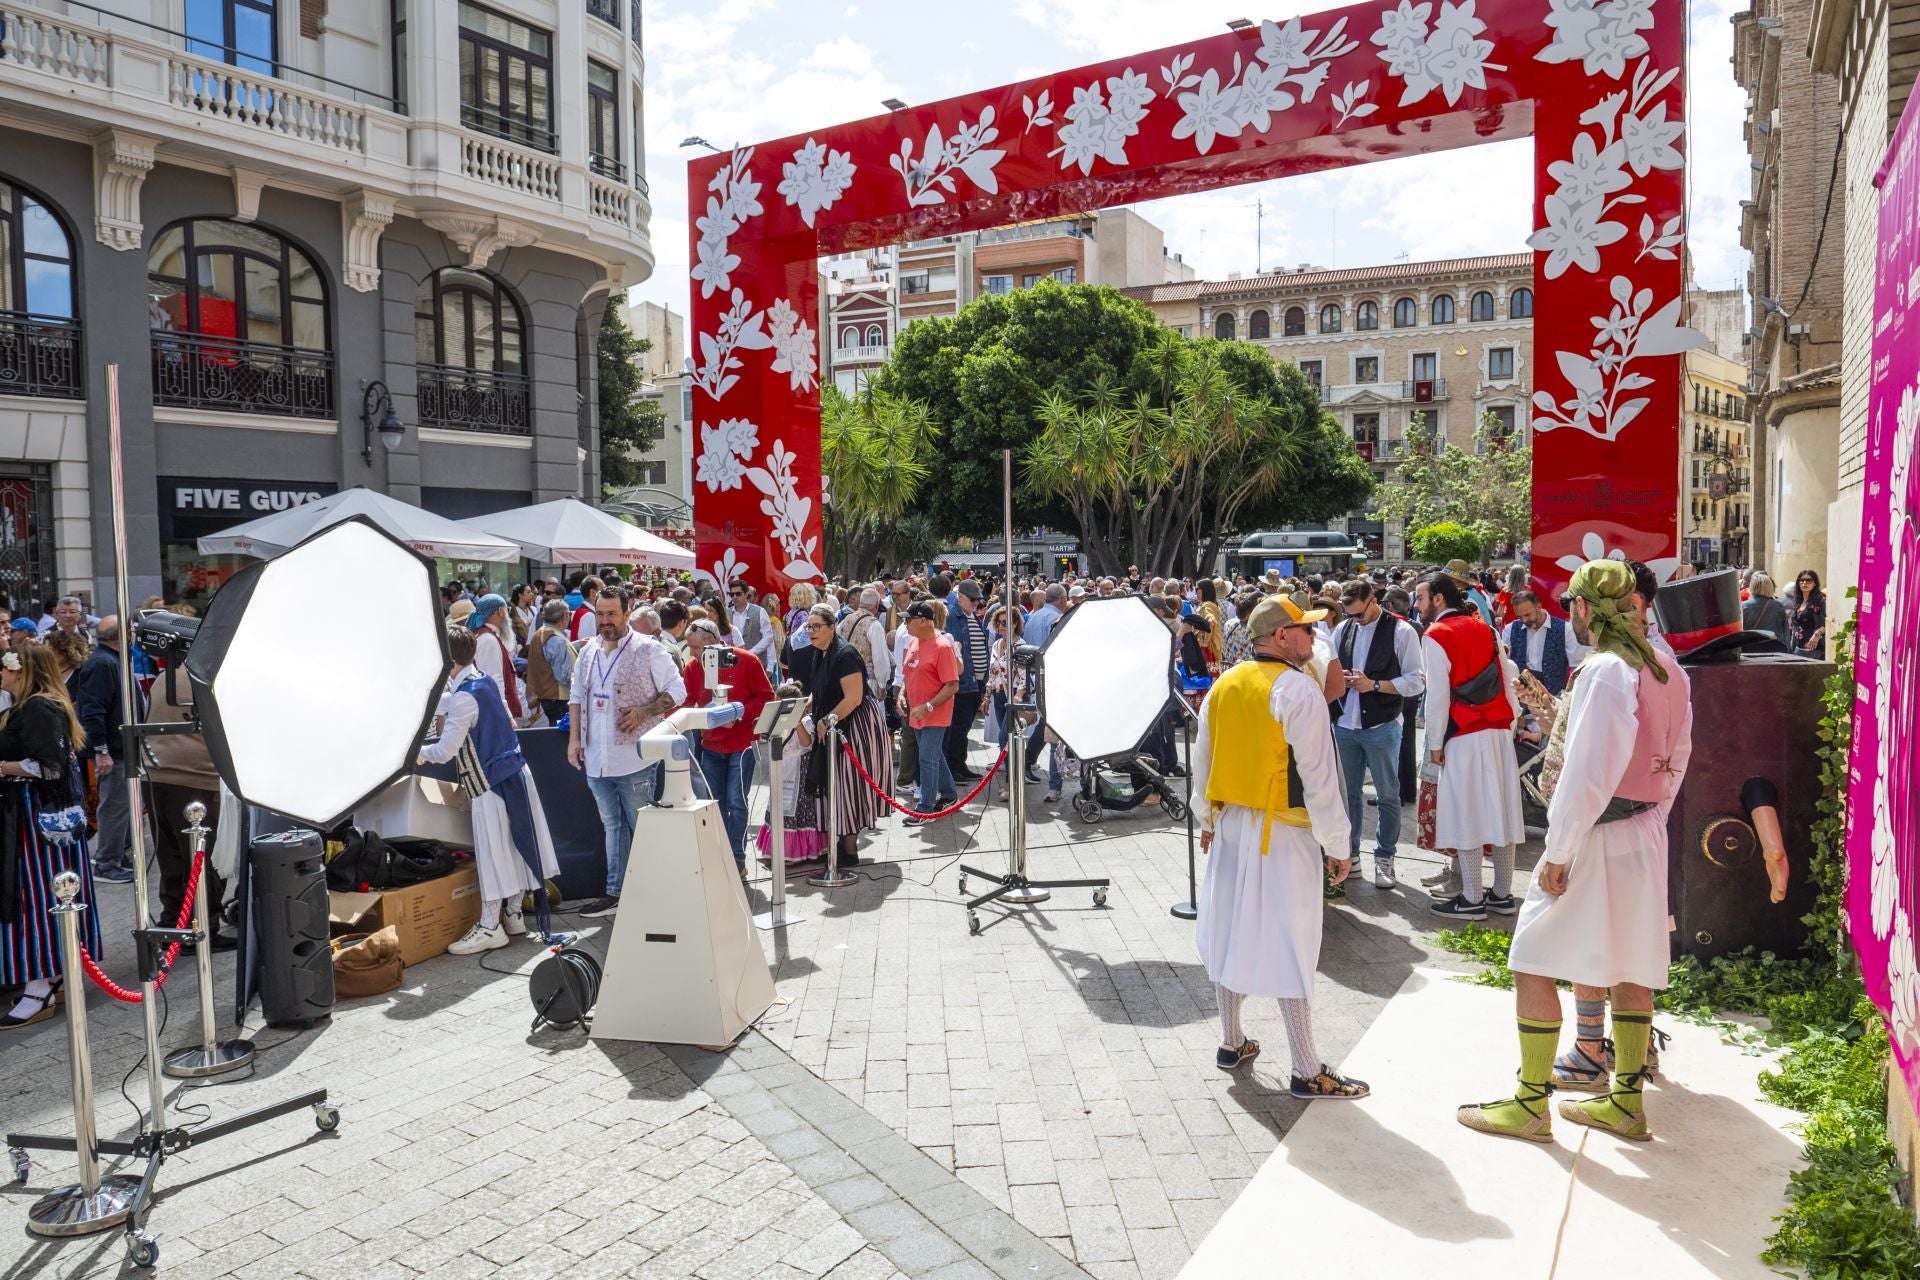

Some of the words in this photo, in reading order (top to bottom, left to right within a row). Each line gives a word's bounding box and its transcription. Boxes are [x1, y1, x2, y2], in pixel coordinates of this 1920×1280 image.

[175, 488, 241, 509] FIVE
[413, 543, 434, 551] GUYS
[457, 563, 483, 573] OPEN
